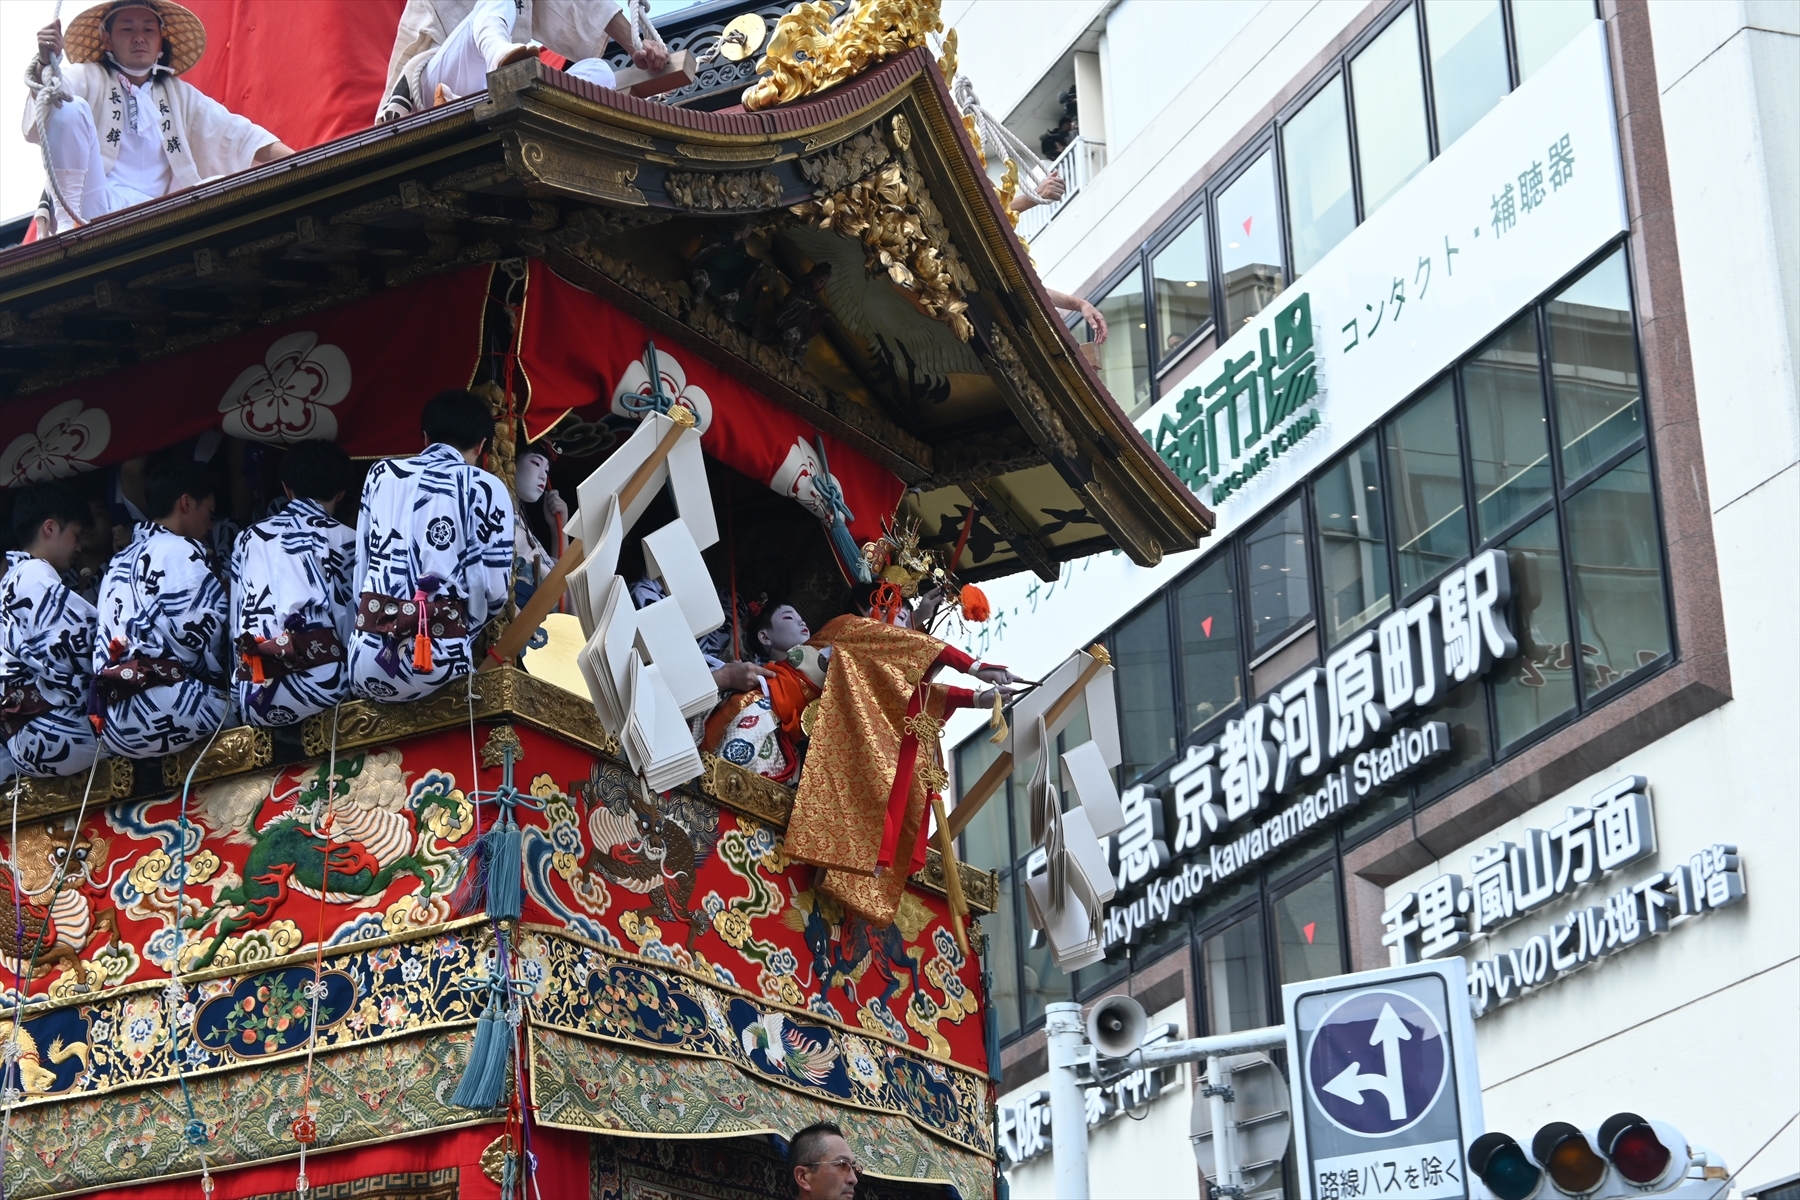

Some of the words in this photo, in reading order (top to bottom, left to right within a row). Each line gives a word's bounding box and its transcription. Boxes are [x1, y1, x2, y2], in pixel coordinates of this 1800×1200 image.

[106, 87, 122, 148] 長刀鉾
[1341, 132, 1576, 354] コンタクト・補聴器
[1141, 291, 1319, 493] 鏡市場
[1212, 446, 1270, 507] MEGANE
[1271, 407, 1322, 459] ICHIBA
[1102, 896, 1147, 953] nkyu
[1146, 764, 1349, 922] Kyoto-kawaramachi
[1352, 719, 1440, 797] Station
[1466, 844, 1733, 1011] かいのビル地下1階
[1318, 1155, 1461, 1200] 路線バスを除く
